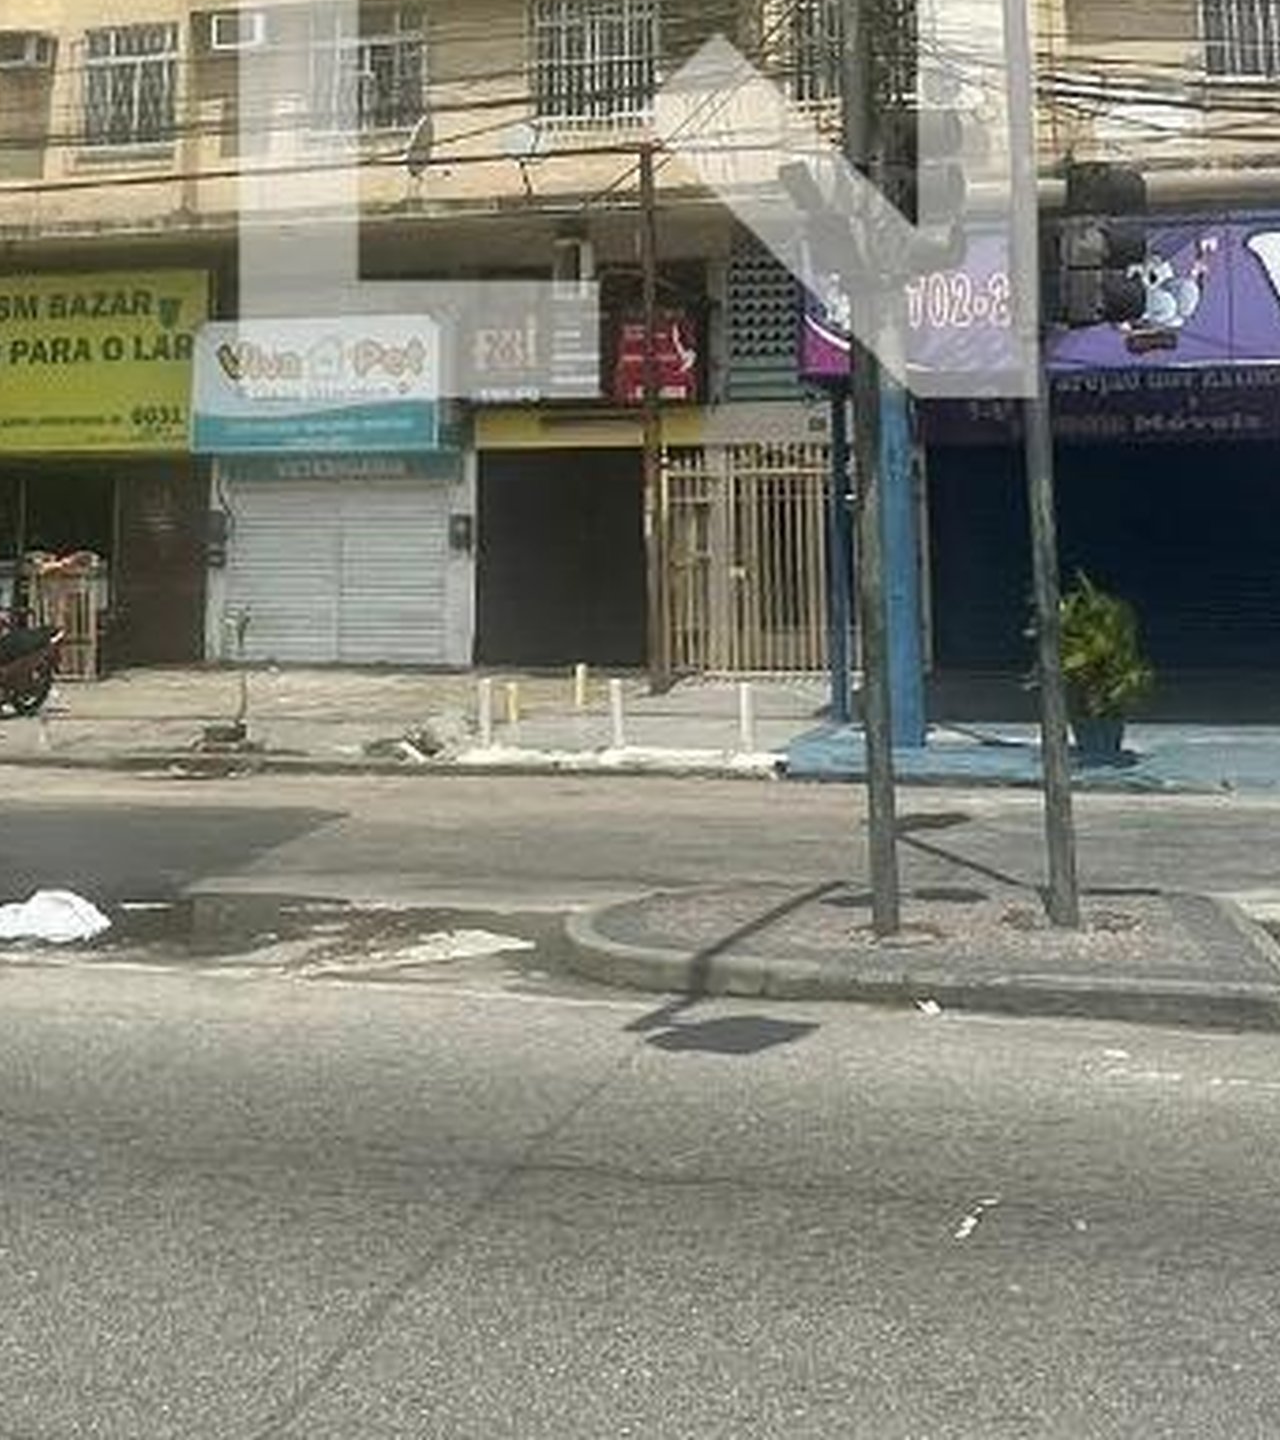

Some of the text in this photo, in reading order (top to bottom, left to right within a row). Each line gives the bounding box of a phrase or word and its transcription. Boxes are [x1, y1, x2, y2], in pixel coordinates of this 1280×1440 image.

[47, 291, 150, 318] BAZAR
[9, 337, 90, 364] PARA
[102, 336, 123, 362] O
[134, 334, 193, 361] LAR
